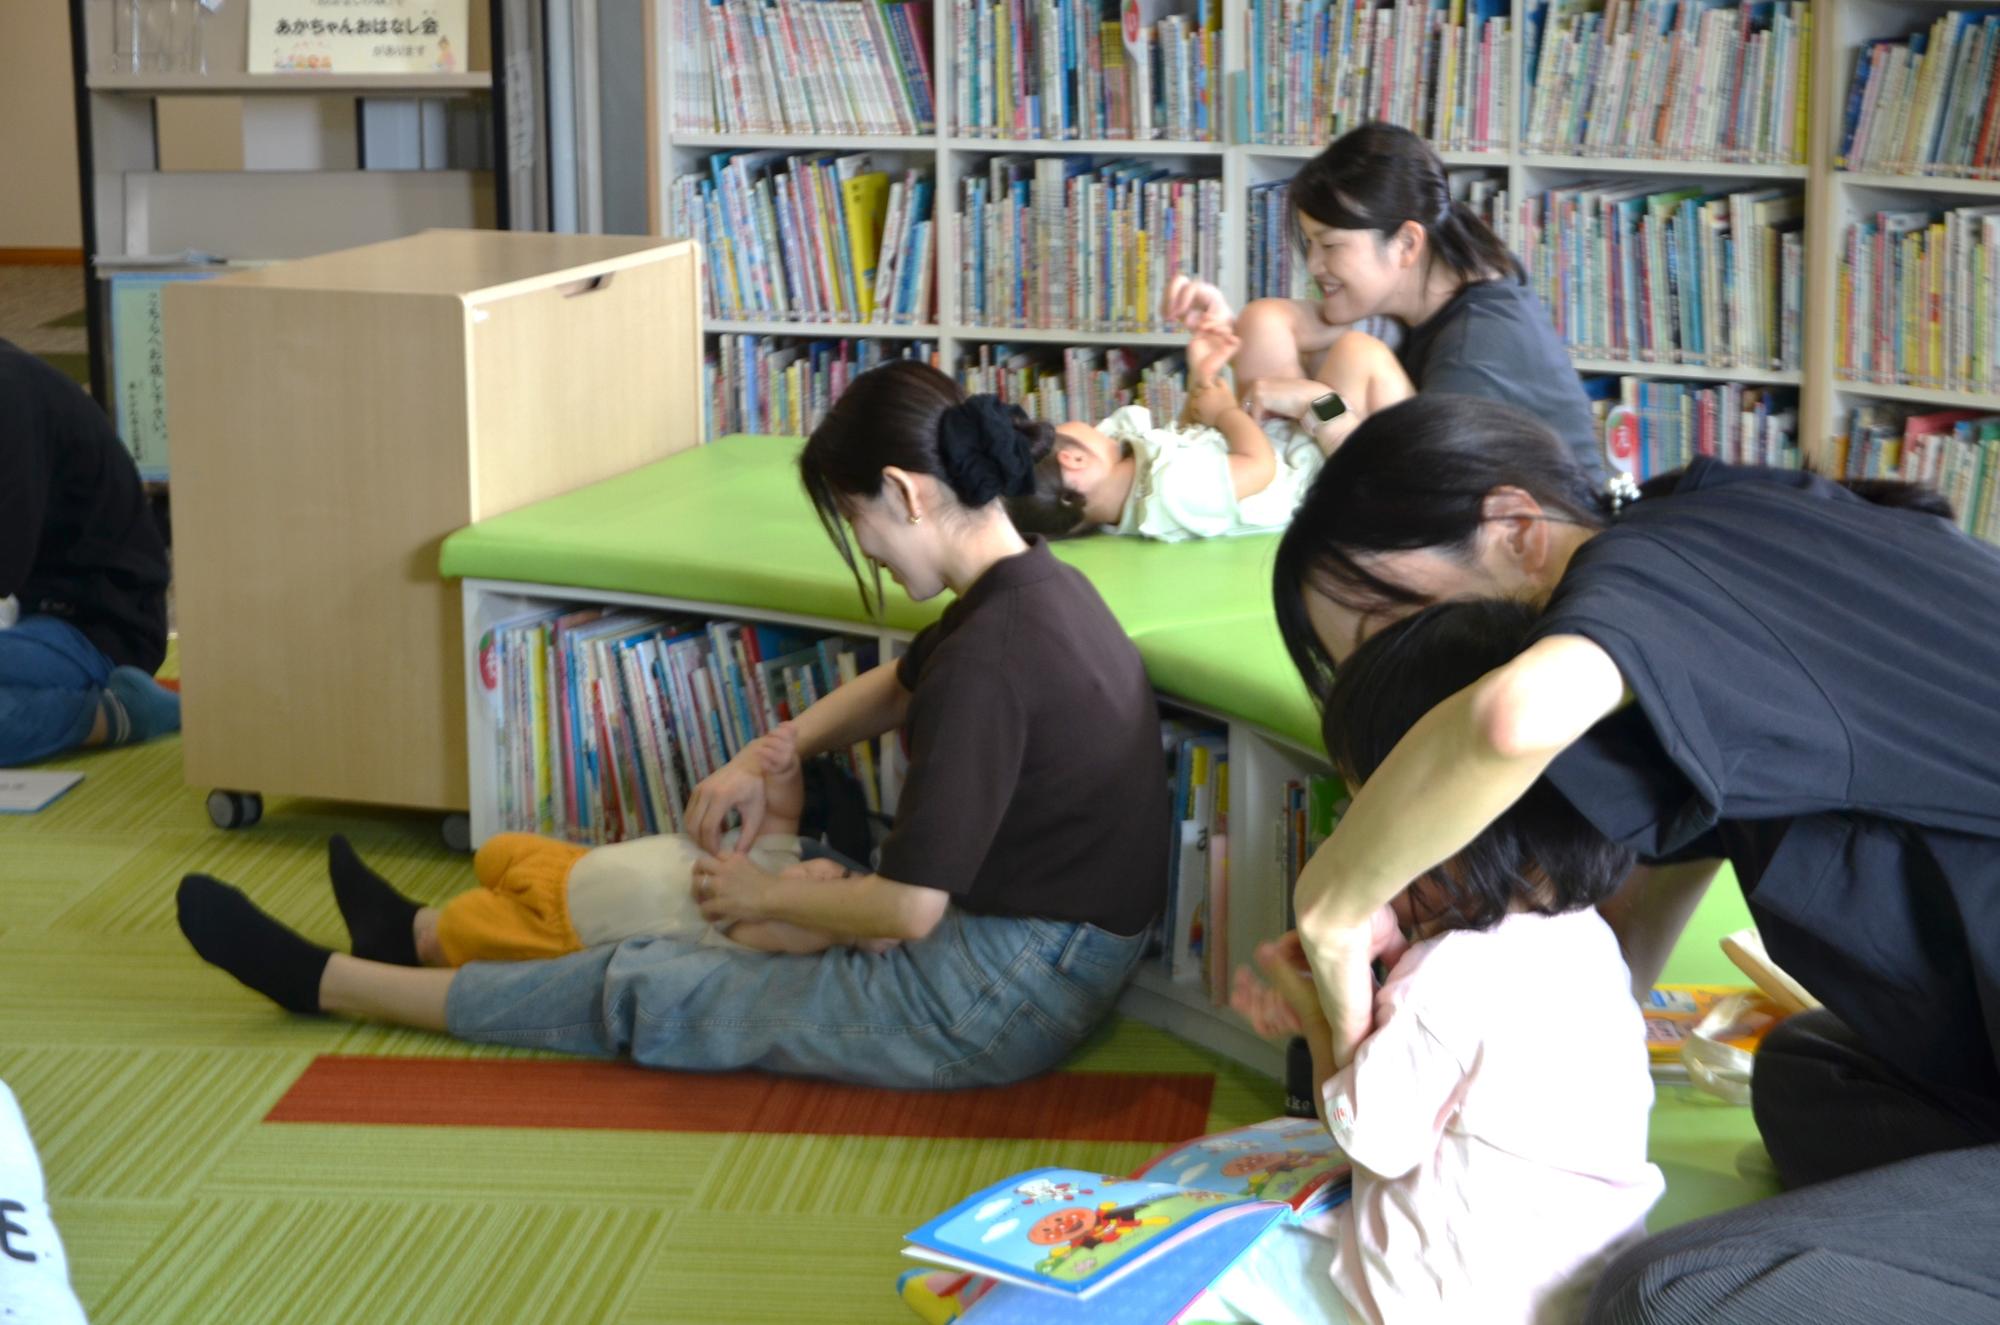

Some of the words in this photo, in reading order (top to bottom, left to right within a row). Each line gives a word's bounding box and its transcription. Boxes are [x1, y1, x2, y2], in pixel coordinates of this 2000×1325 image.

[274, 17, 439, 35] あかちゃんおはなし会
